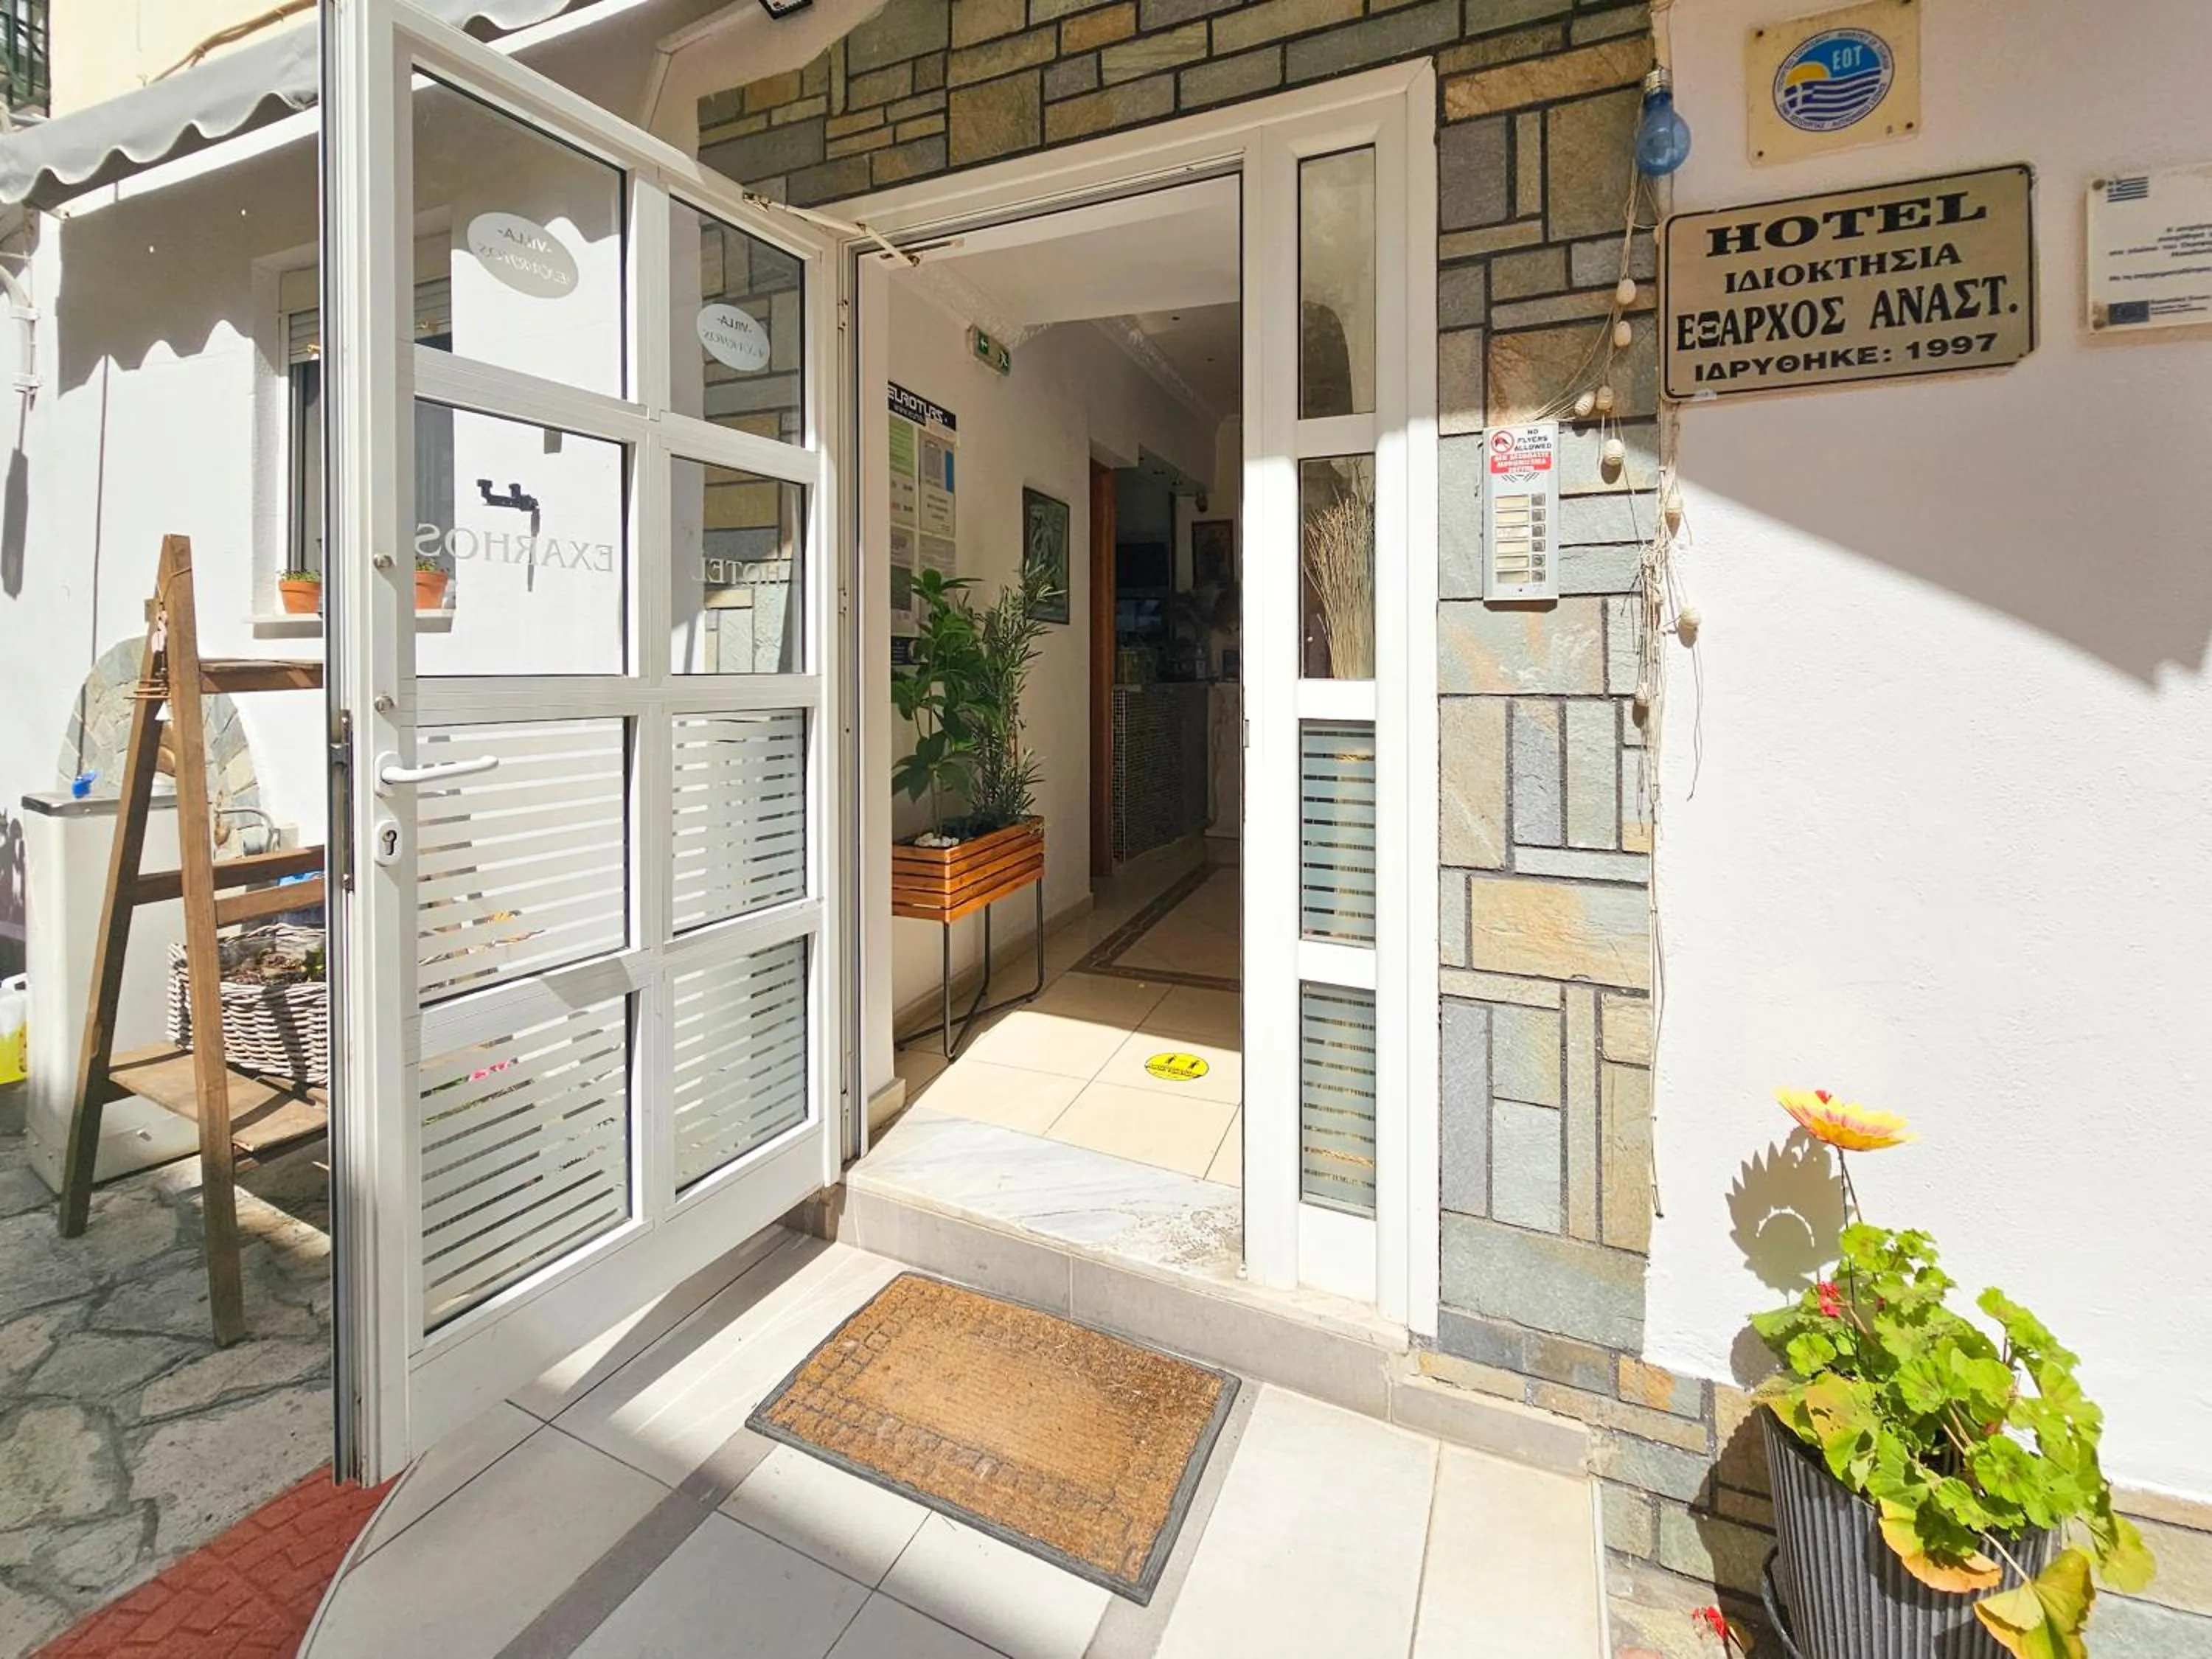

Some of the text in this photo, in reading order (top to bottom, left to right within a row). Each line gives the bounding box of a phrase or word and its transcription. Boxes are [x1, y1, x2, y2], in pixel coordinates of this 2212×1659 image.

[1706, 191, 1986, 257] HOTEL
[1725, 243, 1964, 293] ΙΔΙΟΚΤΗΣΙΑ
[1676, 275, 2018, 351] ΕΞΑΡΧΟΣ ΑΝΑΣΤ.
[1695, 333, 1997, 382] ΙΔΡΥΘΗΚΕ: 1997
[1514, 443, 1552, 451] ALLOWED
